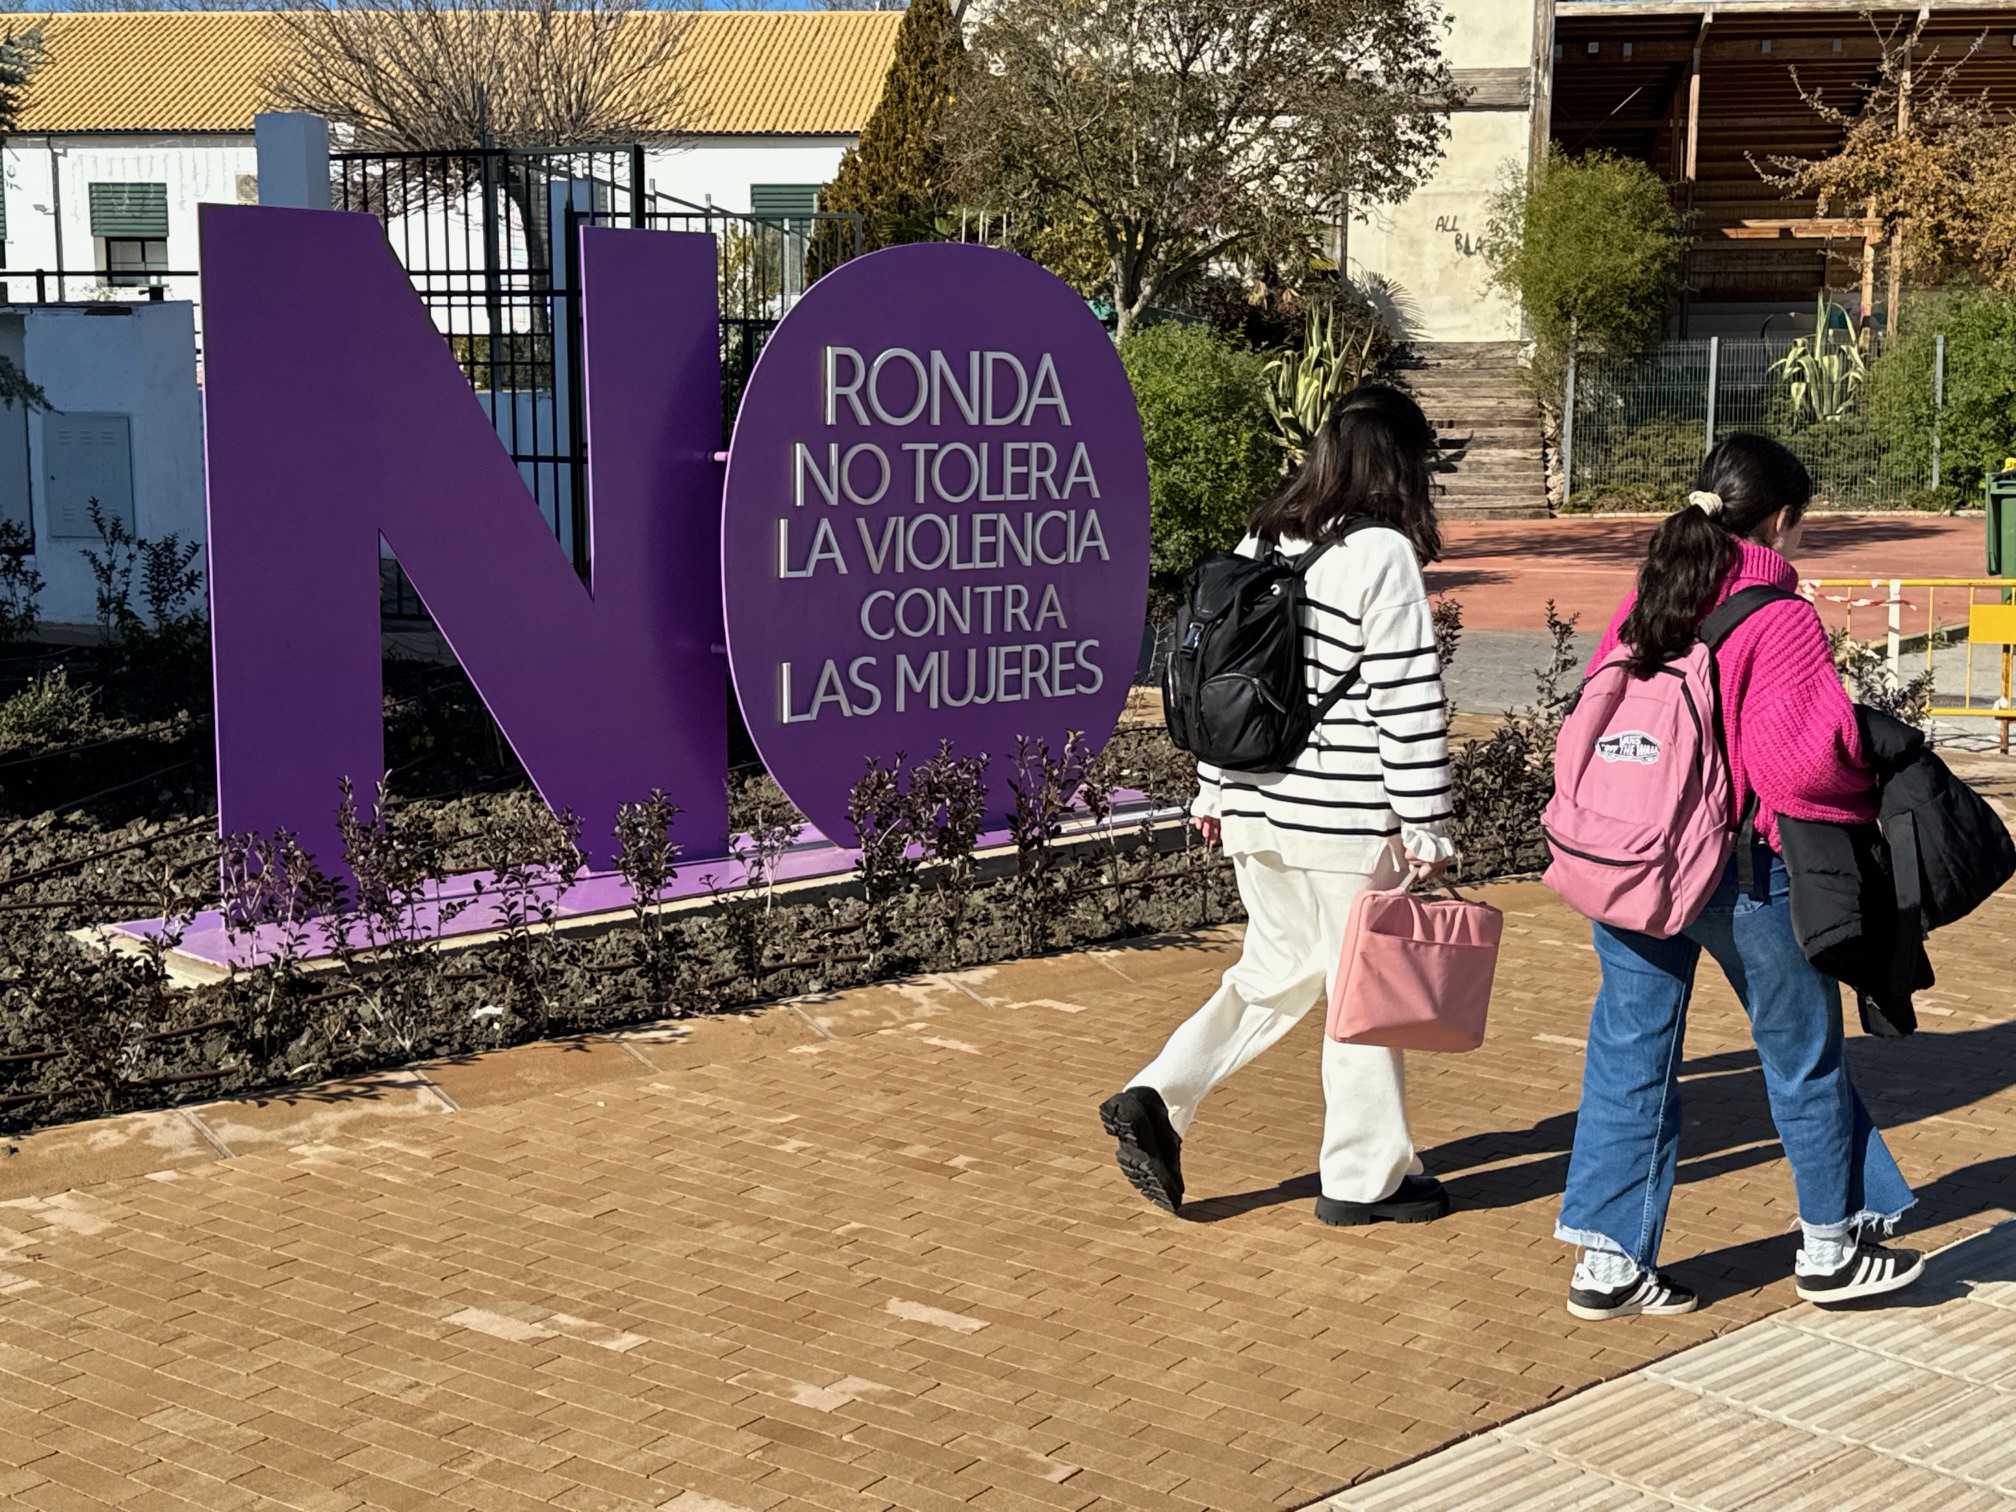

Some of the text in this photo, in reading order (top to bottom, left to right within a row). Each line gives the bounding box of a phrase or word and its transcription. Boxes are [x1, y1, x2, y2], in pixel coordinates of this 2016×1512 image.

[1435, 215, 1459, 232] ALL
[825, 345, 1072, 426] RONDA
[794, 441, 1101, 507] NO TOLERA
[778, 508, 1110, 579] LA VIOLENCIA
[860, 583, 1068, 641] CONTRA
[780, 639, 1104, 724] LAS MUJERES
